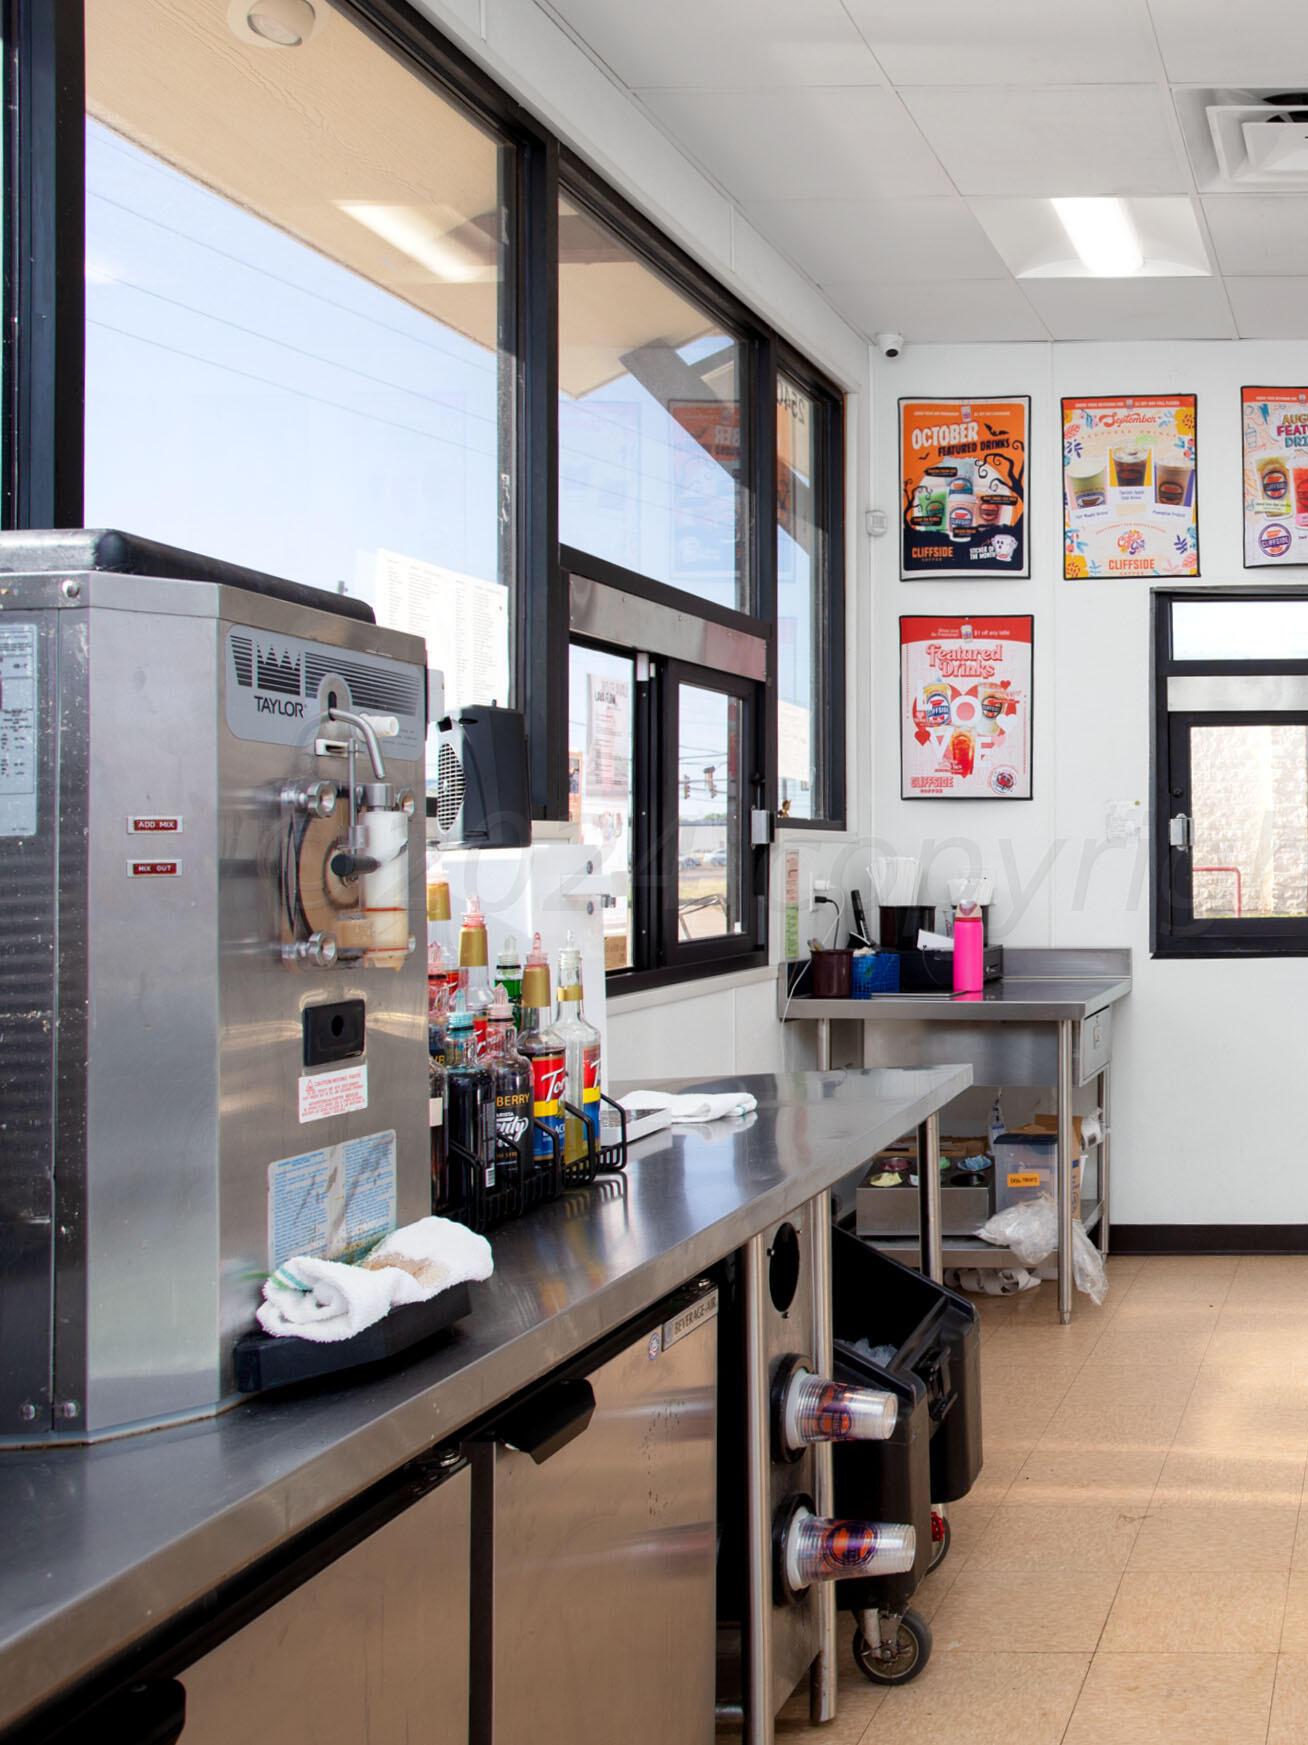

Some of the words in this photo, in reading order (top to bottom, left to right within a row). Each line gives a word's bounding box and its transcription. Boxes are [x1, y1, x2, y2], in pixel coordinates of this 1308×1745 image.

[1099, 412, 1156, 428] September
[912, 421, 979, 450] OCTOBER
[938, 442, 978, 457] FEATURED
[980, 438, 1010, 451] DRINKS
[911, 546, 954, 558] CLIFFSIDE
[1108, 559, 1155, 570] CLIFFSIDE
[926, 644, 1003, 667] Featured
[940, 660, 995, 679] Drinks
[253, 696, 305, 719] TAYLOR
[911, 776, 954, 788] CLIFFSIDE
[138, 819, 156, 830] ADD
[160, 819, 175, 830] MIX
[138, 863, 153, 873] MIX
[157, 863, 171, 873] OUT
[673, 1295, 717, 1335] BEVERAGE-AIR
